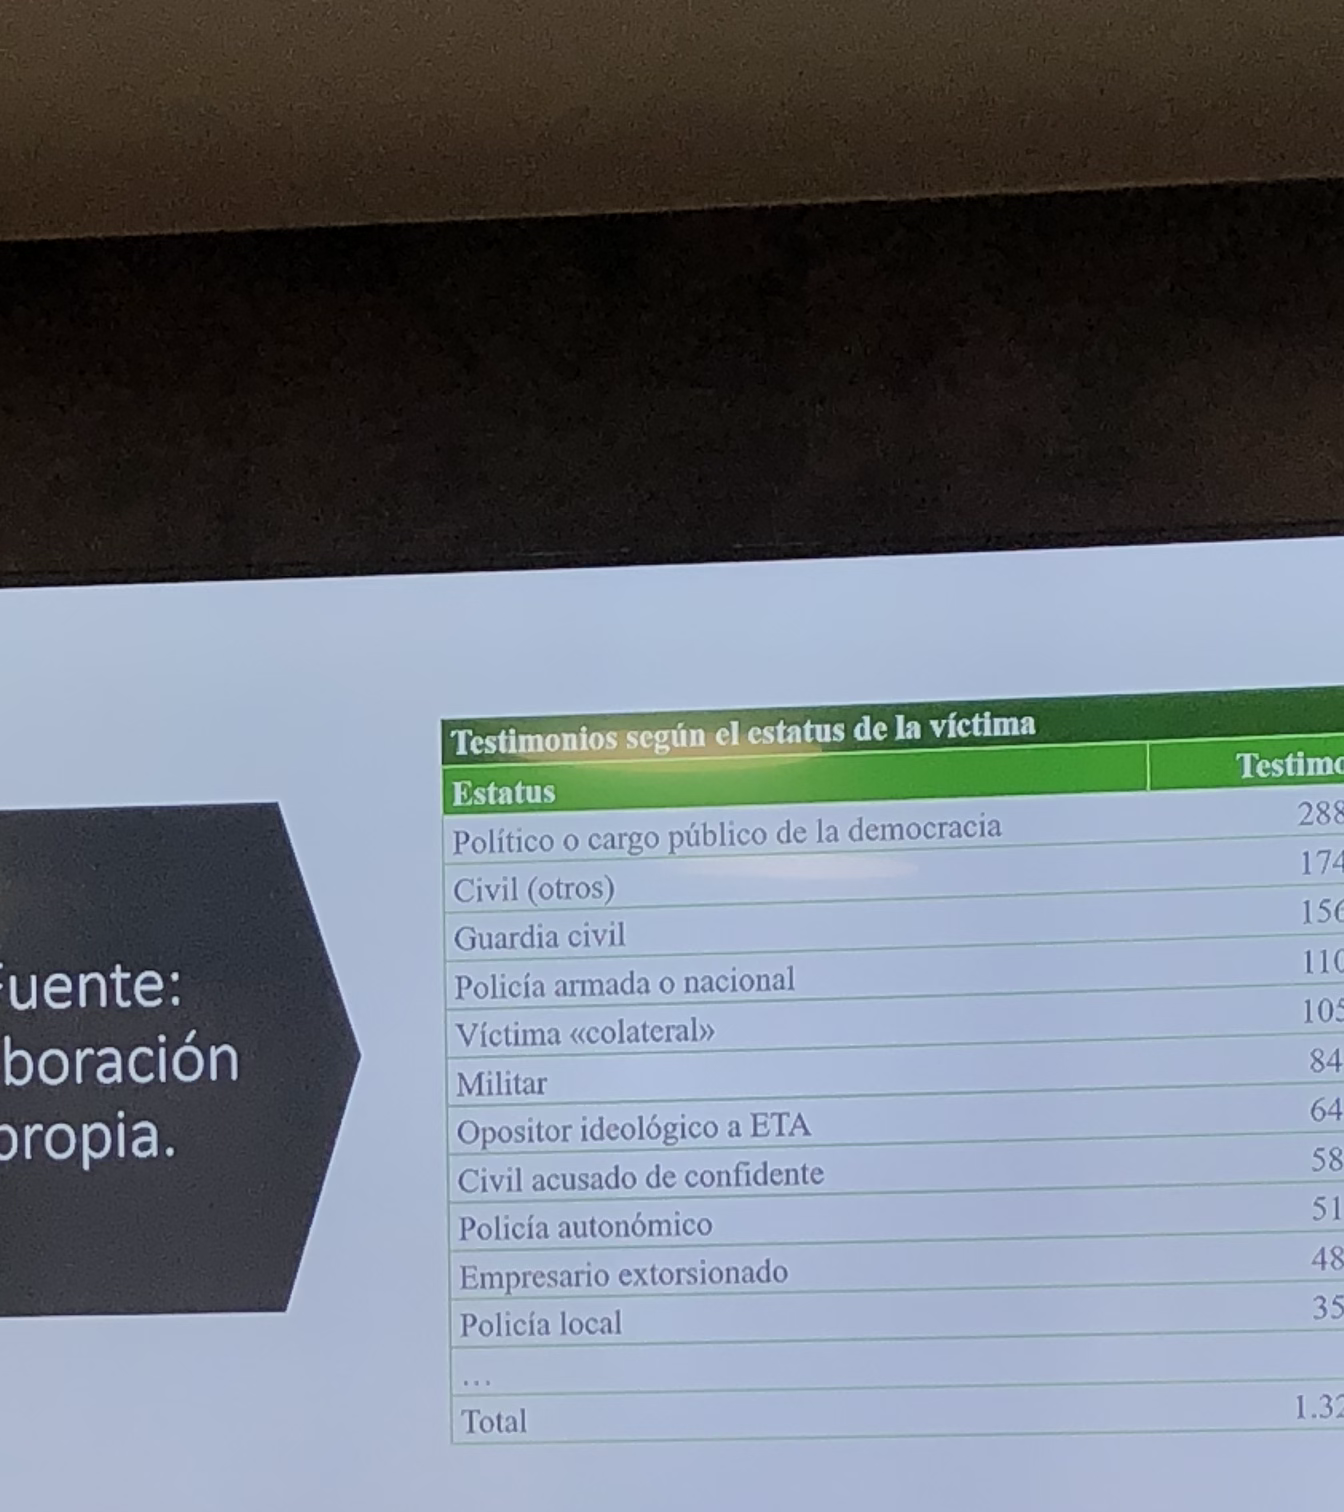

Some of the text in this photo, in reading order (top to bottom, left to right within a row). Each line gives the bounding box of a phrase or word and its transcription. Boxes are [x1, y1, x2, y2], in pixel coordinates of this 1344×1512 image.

[451, 711, 1035, 757] Testimonios según el estatus de la víctima
[452, 779, 557, 809] Estatus
[452, 813, 1003, 857] Político o cargo público de la democracia
[452, 873, 616, 904] Civil (otros)
[453, 922, 626, 951] Guardia civil
[453, 966, 796, 1001] Policía armada o nacional
[454, 1017, 716, 1049] Víctima «colateral»
[1309, 1046, 1344, 1074] 84
[456, 1071, 548, 1099] Militar
[1310, 1096, 1344, 1123] 64
[456, 1112, 813, 1150] Opositor ideológico a ETA
[1311, 1145, 1344, 1173] 58
[457, 1161, 826, 1195] Civil acusado de confidente
[1311, 1195, 1342, 1222] 51
[458, 1211, 714, 1242] Policía autonómico
[459, 1258, 789, 1295] Empresario extorsionado
[459, 1310, 623, 1338] Policía local
[460, 1408, 529, 1435] Total
